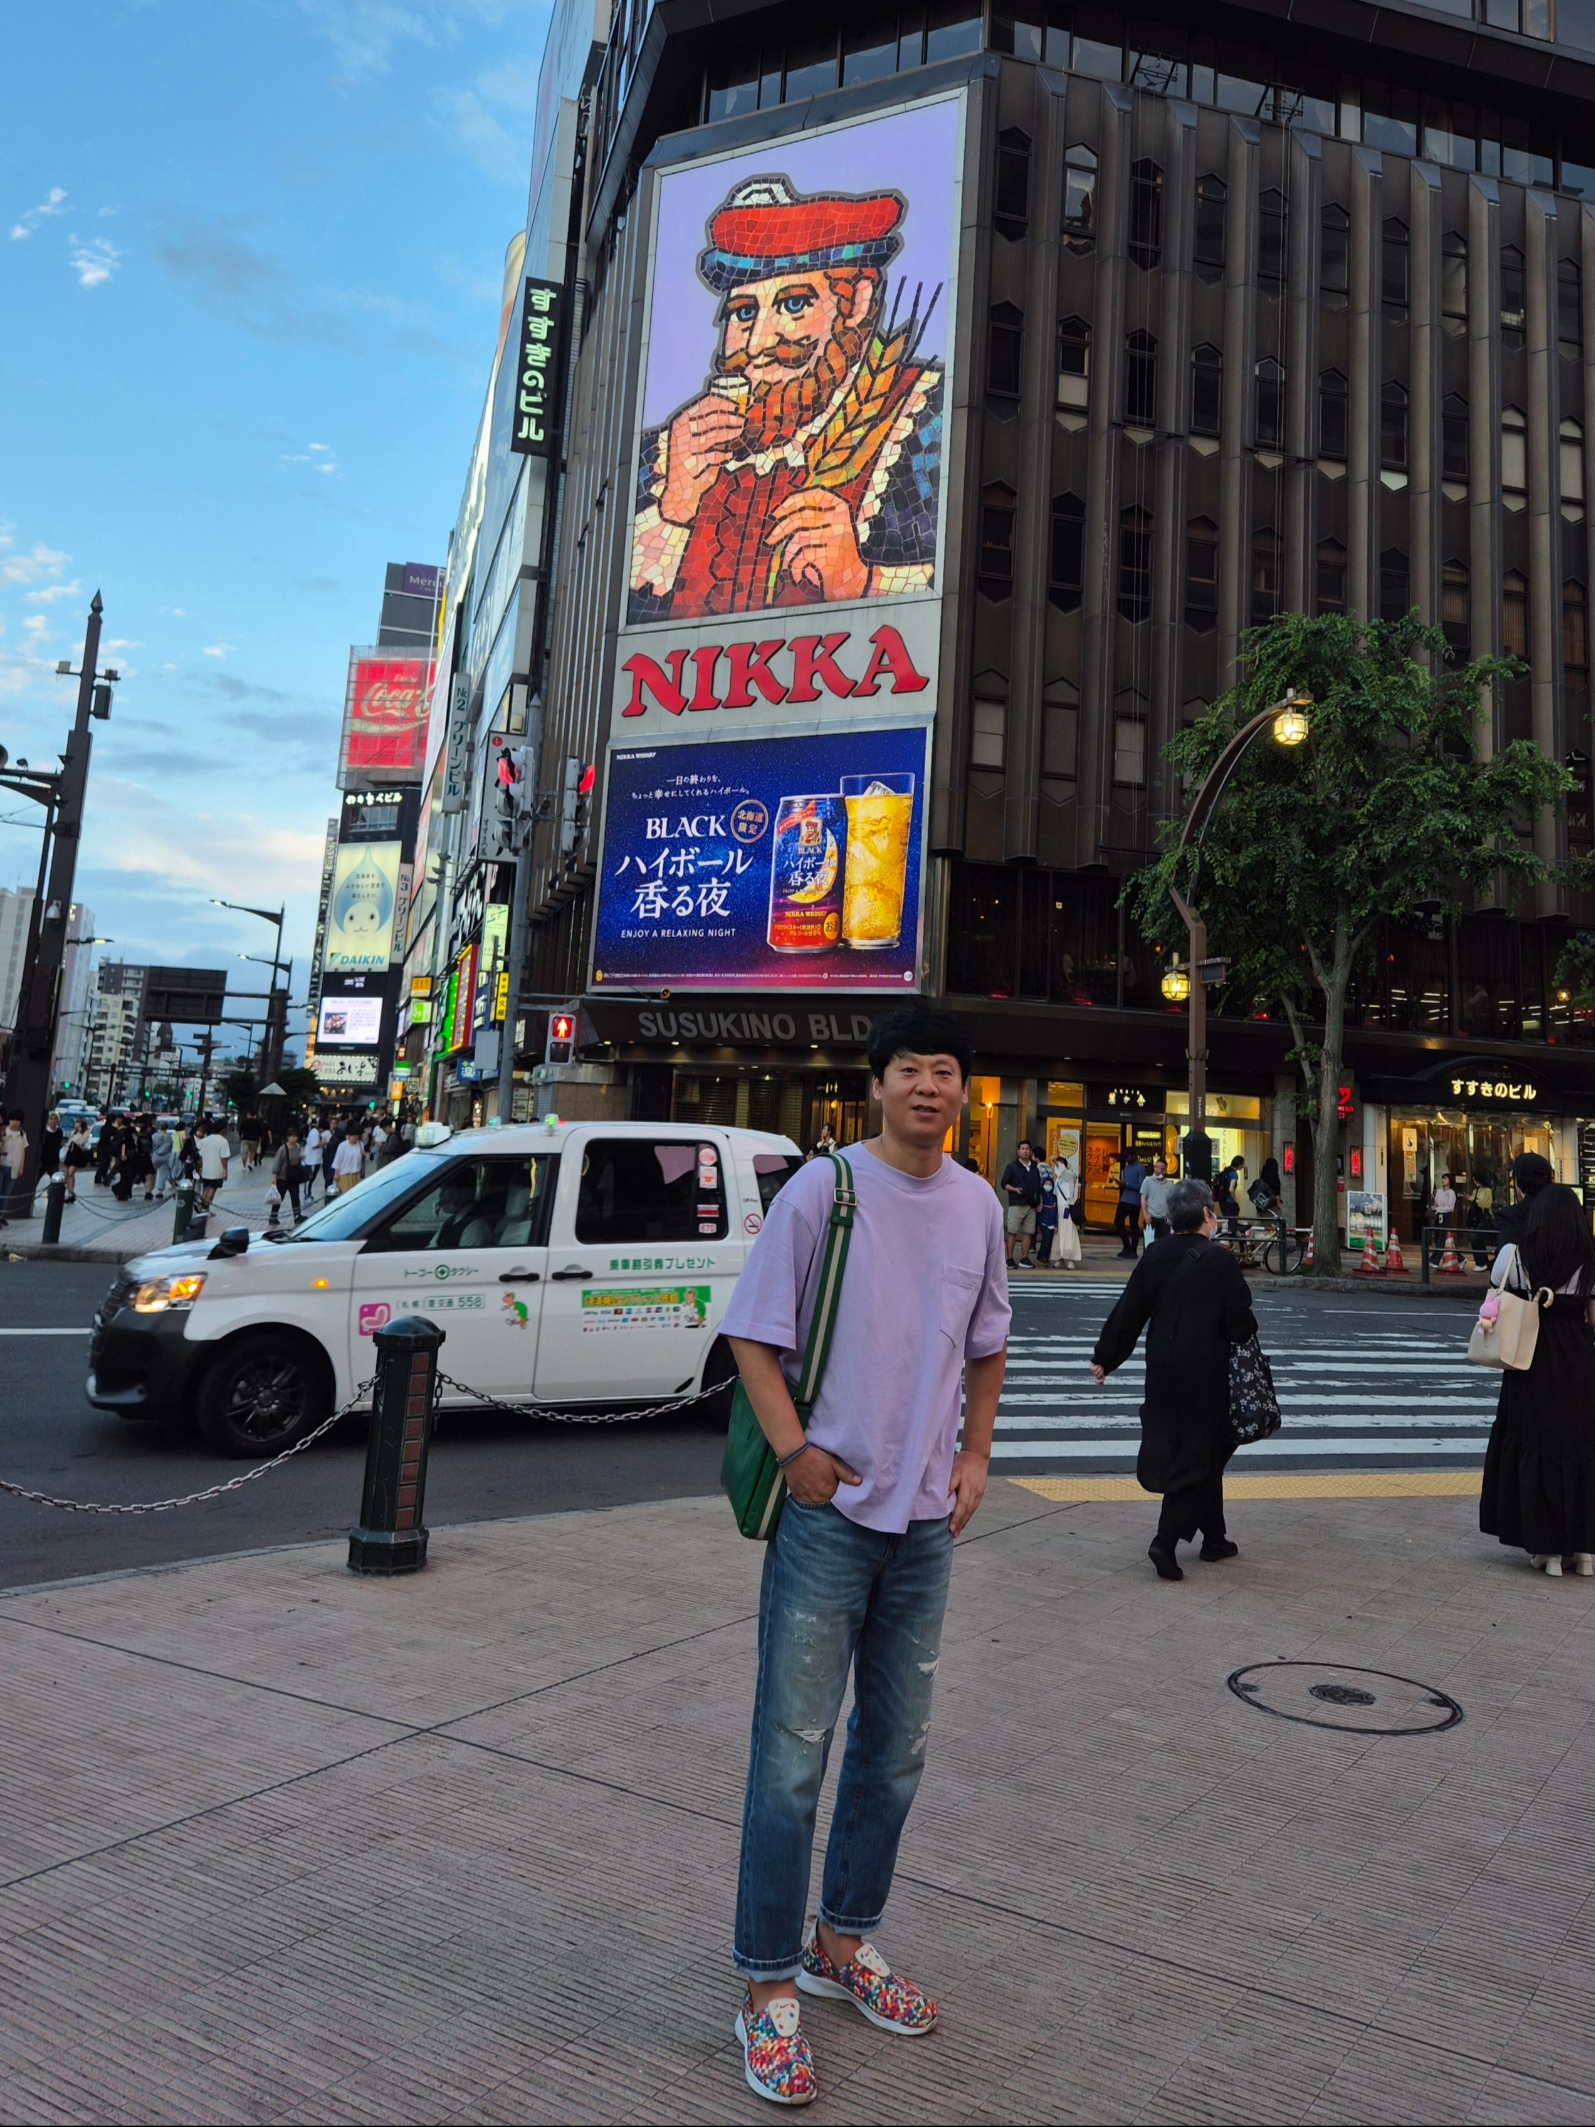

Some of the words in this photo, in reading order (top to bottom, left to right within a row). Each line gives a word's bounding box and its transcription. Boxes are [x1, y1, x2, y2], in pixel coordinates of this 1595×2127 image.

[518, 288, 557, 442] すすきのビル
[621, 624, 930, 717] NIKKA
[737, 809, 764, 823] 北海道
[646, 815, 727, 840] BLACK
[738, 822, 757, 835] 限定
[798, 847, 823, 855] BLACK
[614, 847, 754, 878] ハイボール
[783, 856, 836, 870] ハイボール
[788, 870, 828, 887] 香る夜
[630, 877, 732, 919] 香る夜
[621, 929, 650, 938] ENJOY
[661, 929, 704, 938] RELAXING
[708, 928, 736, 937] NIGHT
[340, 955, 385, 965] DAIKIN
[638, 1012, 797, 1040] SUSUKINO
[1451, 1079, 1537, 1100] すすきのビル
[404, 1268, 433, 1278] トーコー
[450, 1267, 479, 1276] タクシー
[458, 1296, 482, 1308] 558
